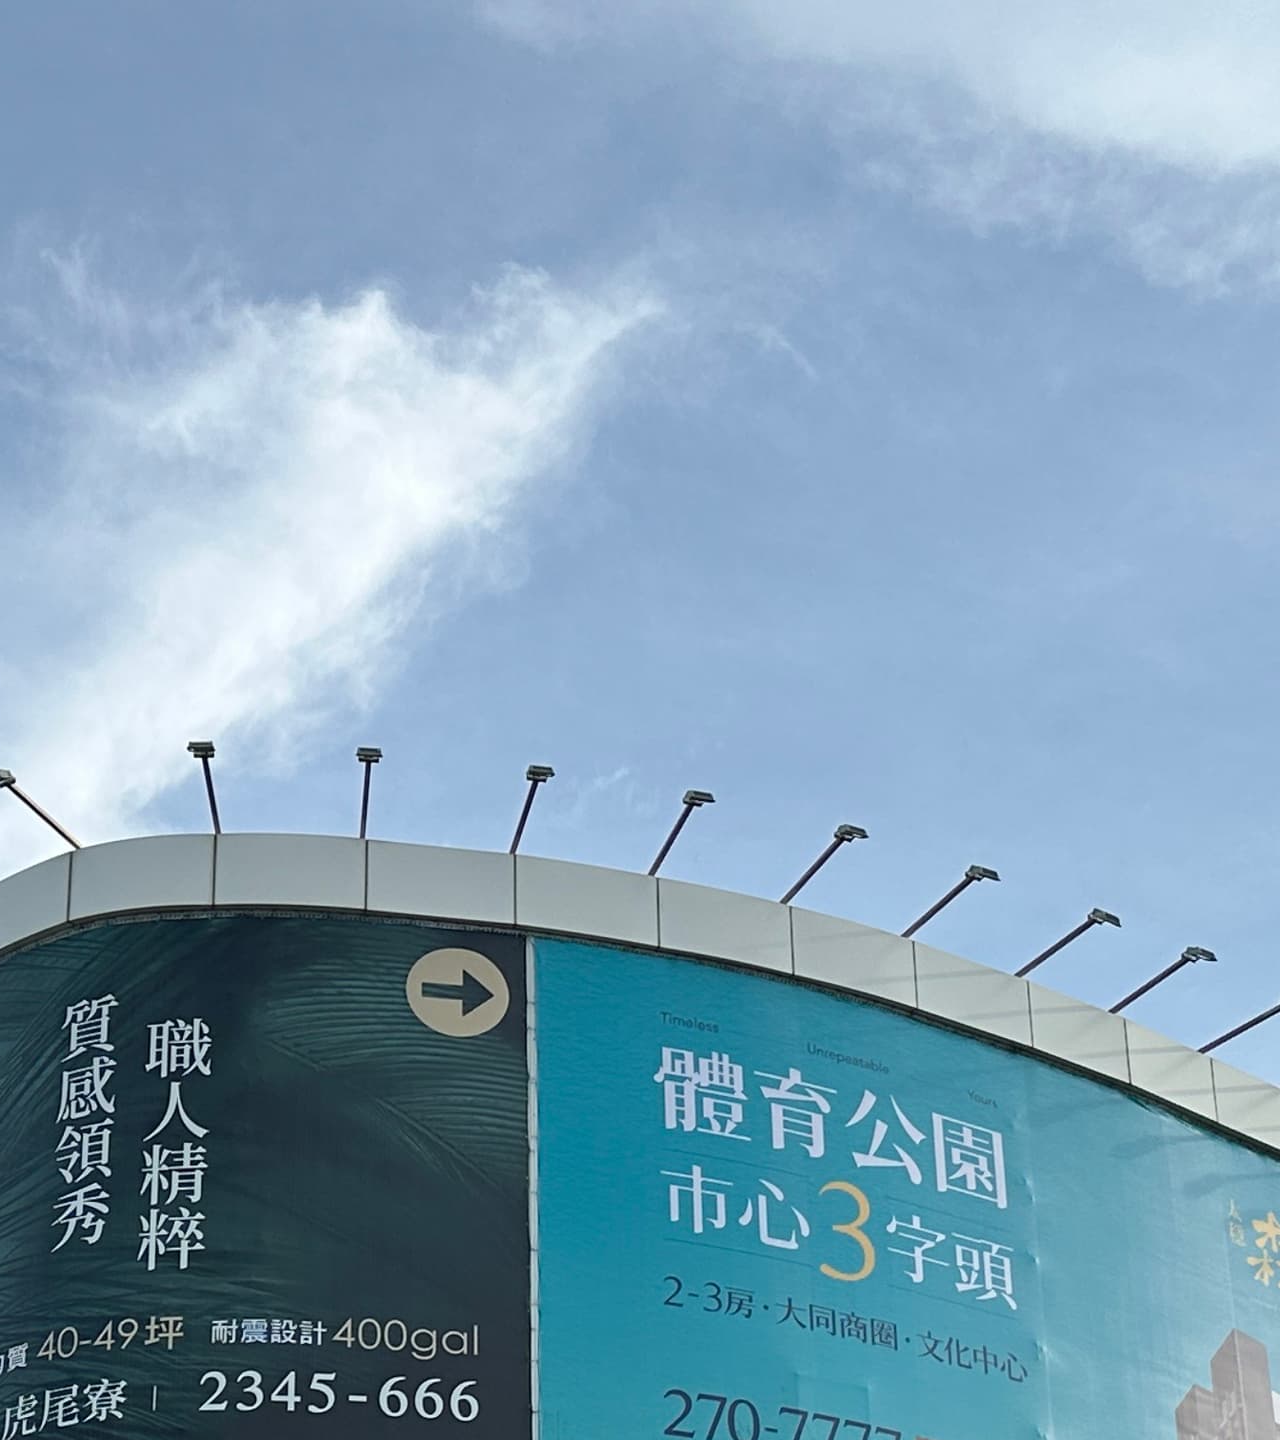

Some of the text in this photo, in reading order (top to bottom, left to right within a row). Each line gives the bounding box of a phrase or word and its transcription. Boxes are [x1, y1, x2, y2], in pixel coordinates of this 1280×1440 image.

[659, 1011, 719, 1033] Timeless
[806, 1042, 890, 1074] Unrepeatable
[50, 994, 119, 1253] 質感領秀
[137, 1018, 212, 1271] 職人精粹
[653, 1046, 1008, 1210] 體育公園
[659, 1164, 1018, 1311] 市心3字頭
[210, 1318, 327, 1346] 耐震設計
[332, 1318, 479, 1360] 400gal
[199, 1370, 480, 1422] 2345-666
